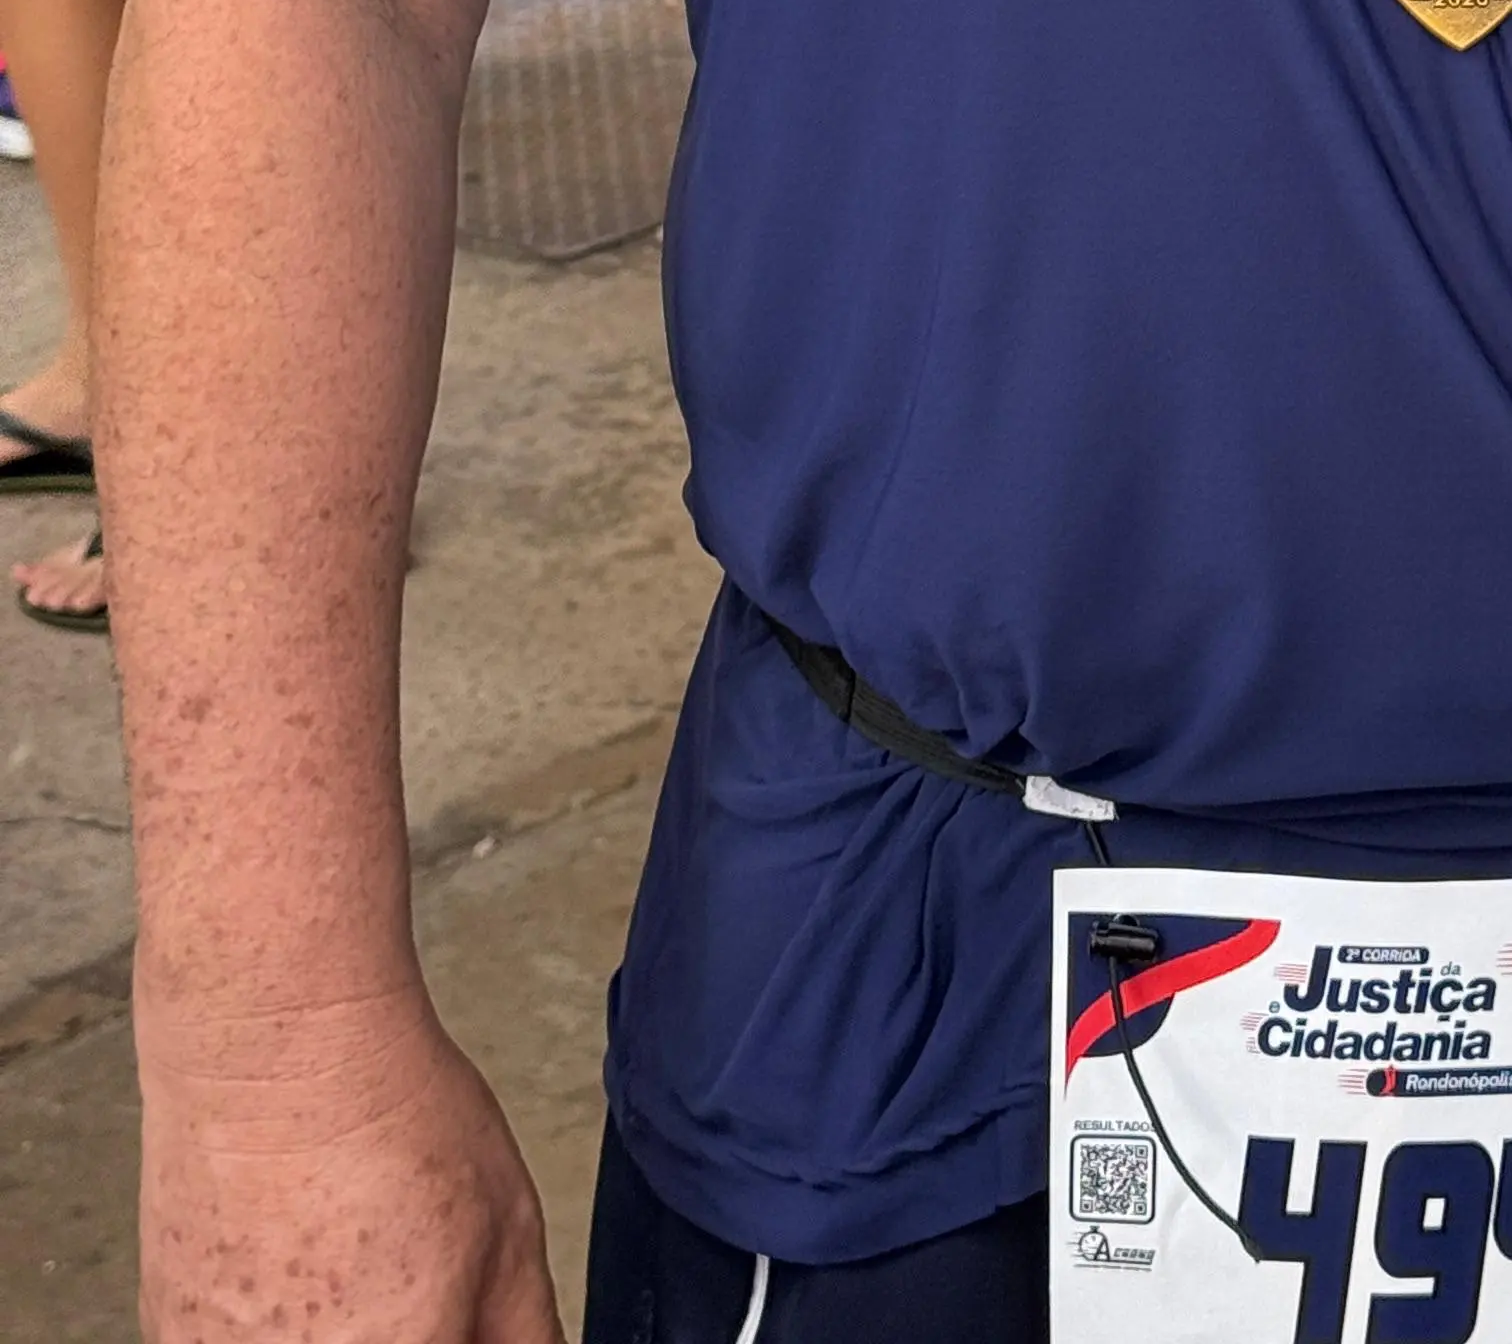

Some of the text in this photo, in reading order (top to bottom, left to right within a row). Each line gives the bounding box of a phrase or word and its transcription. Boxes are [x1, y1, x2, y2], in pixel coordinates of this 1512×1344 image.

[1362, 948, 1421, 962] CORRIDA
[1440, 961, 1461, 976] da
[1283, 945, 1497, 1022] Justiça
[1257, 1000, 1492, 1062] e Cidadania
